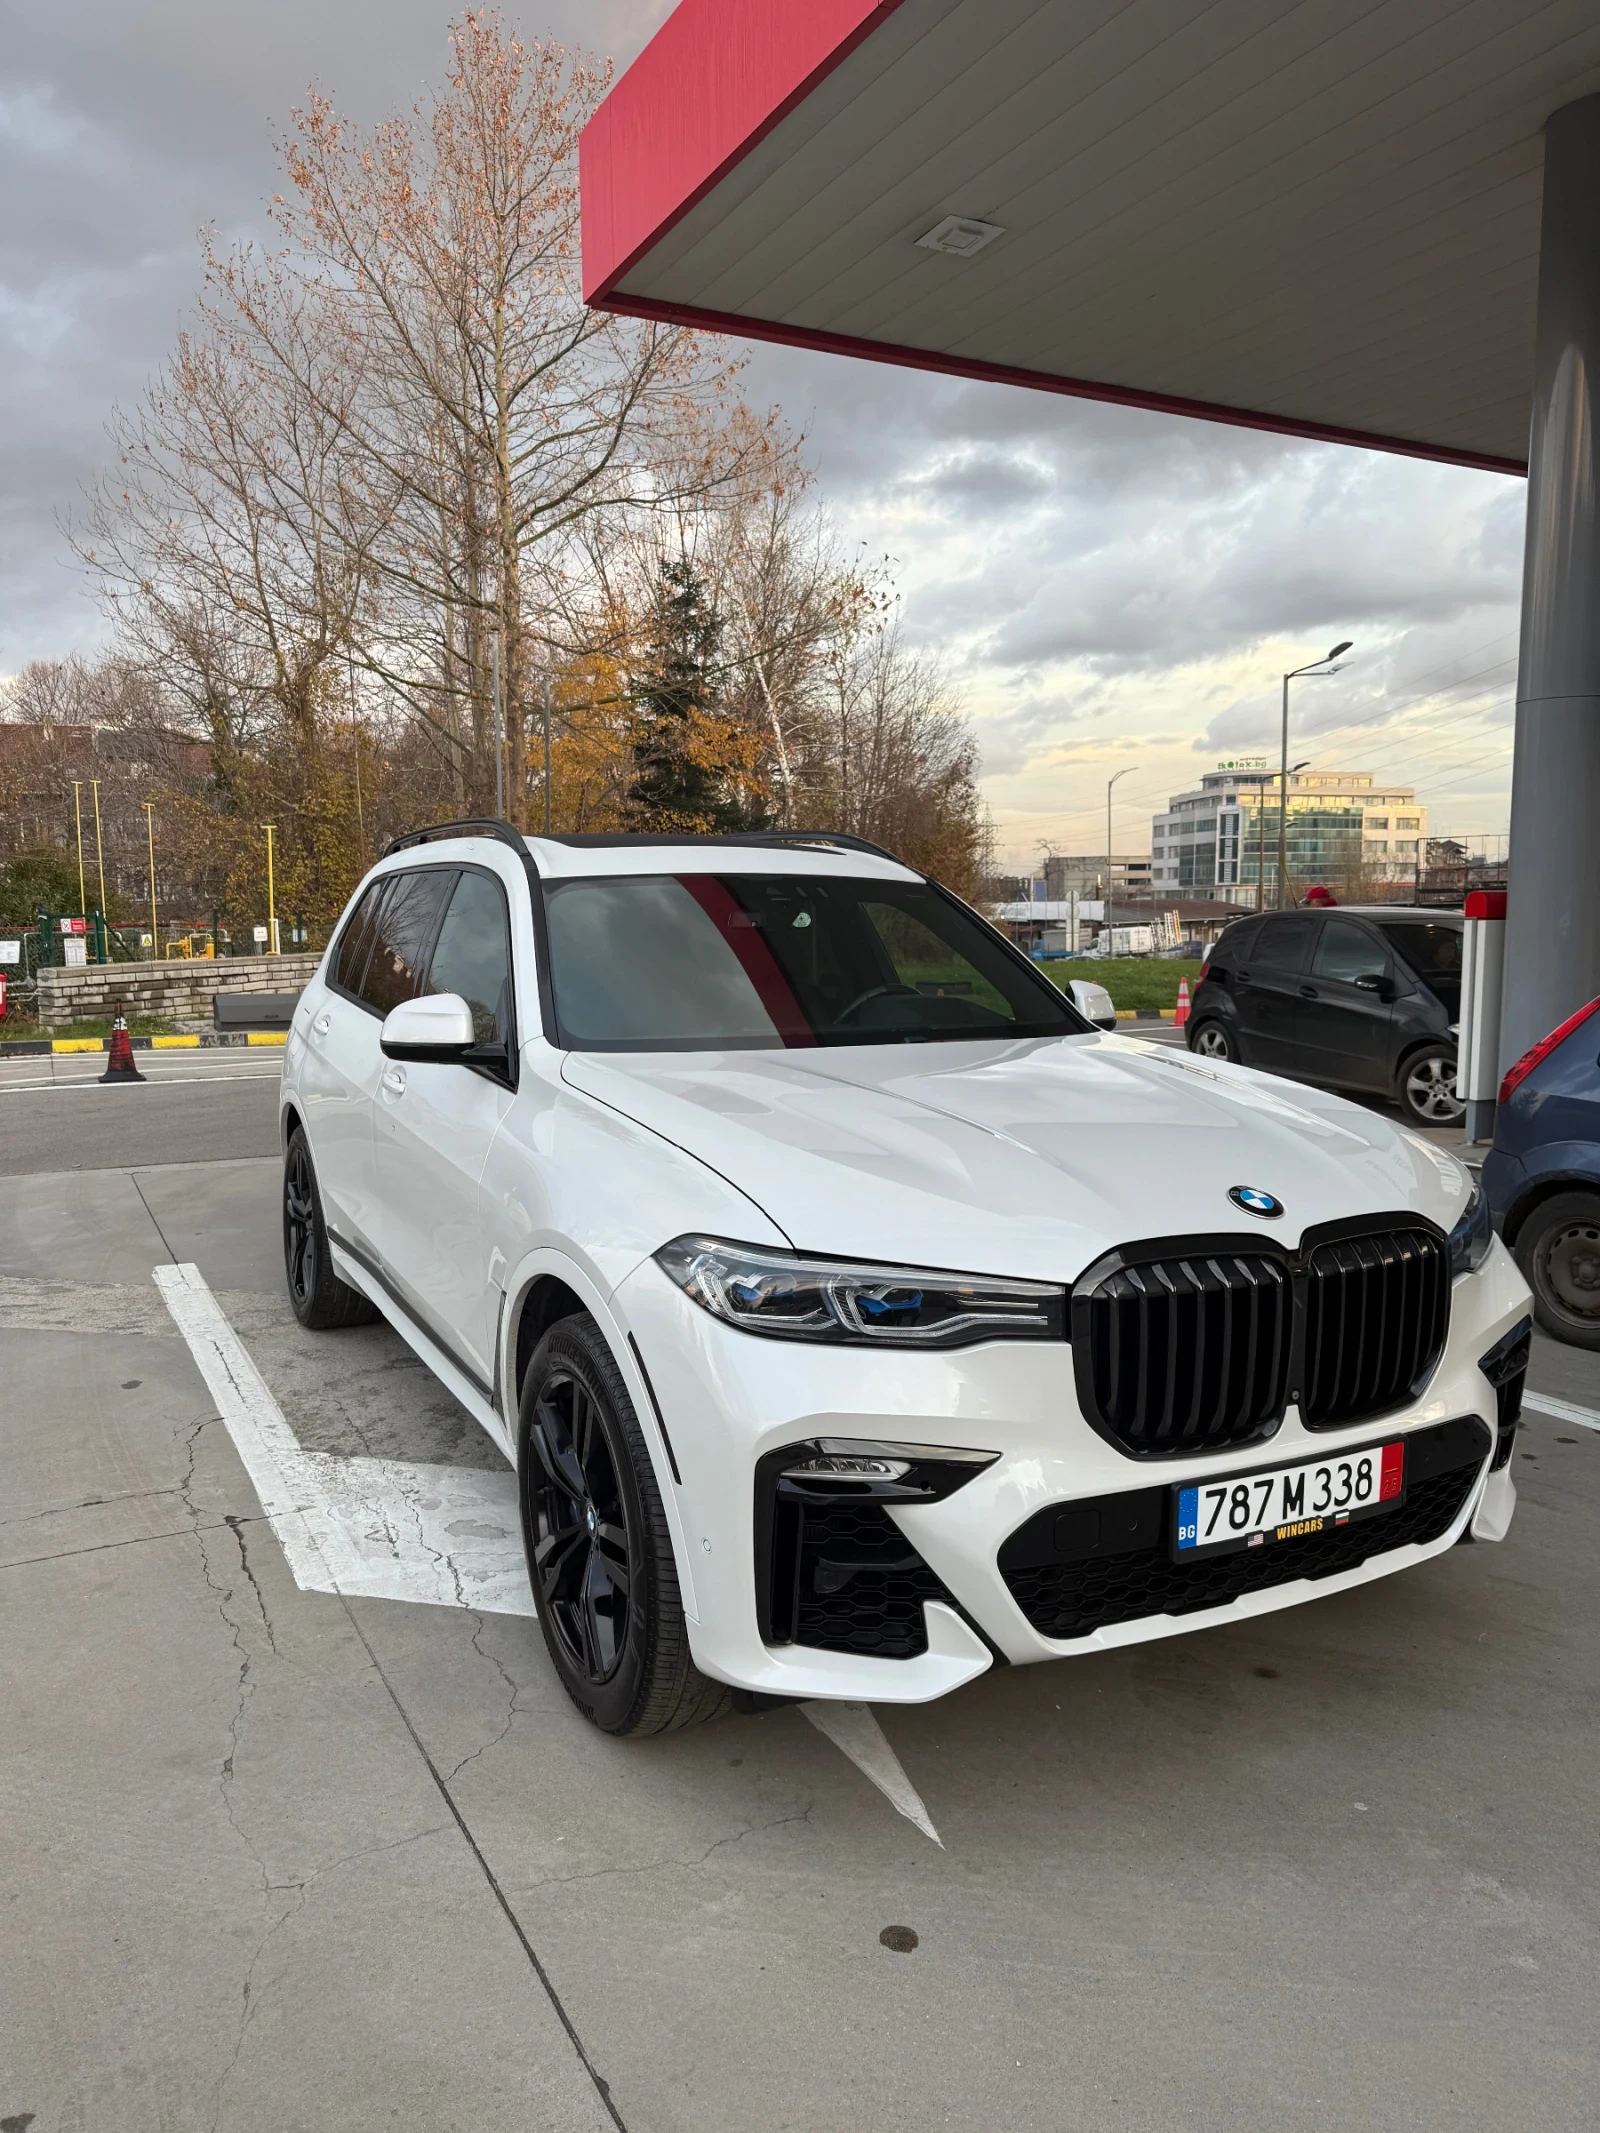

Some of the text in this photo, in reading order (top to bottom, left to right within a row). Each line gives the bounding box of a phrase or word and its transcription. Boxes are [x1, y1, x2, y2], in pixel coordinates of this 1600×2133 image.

[1384, 1478, 1397, 1495] 25
[1204, 1458, 1372, 1537] 787 M 338
[1179, 1525, 1195, 1540] BG
[1276, 1518, 1323, 1540] WINCARS
